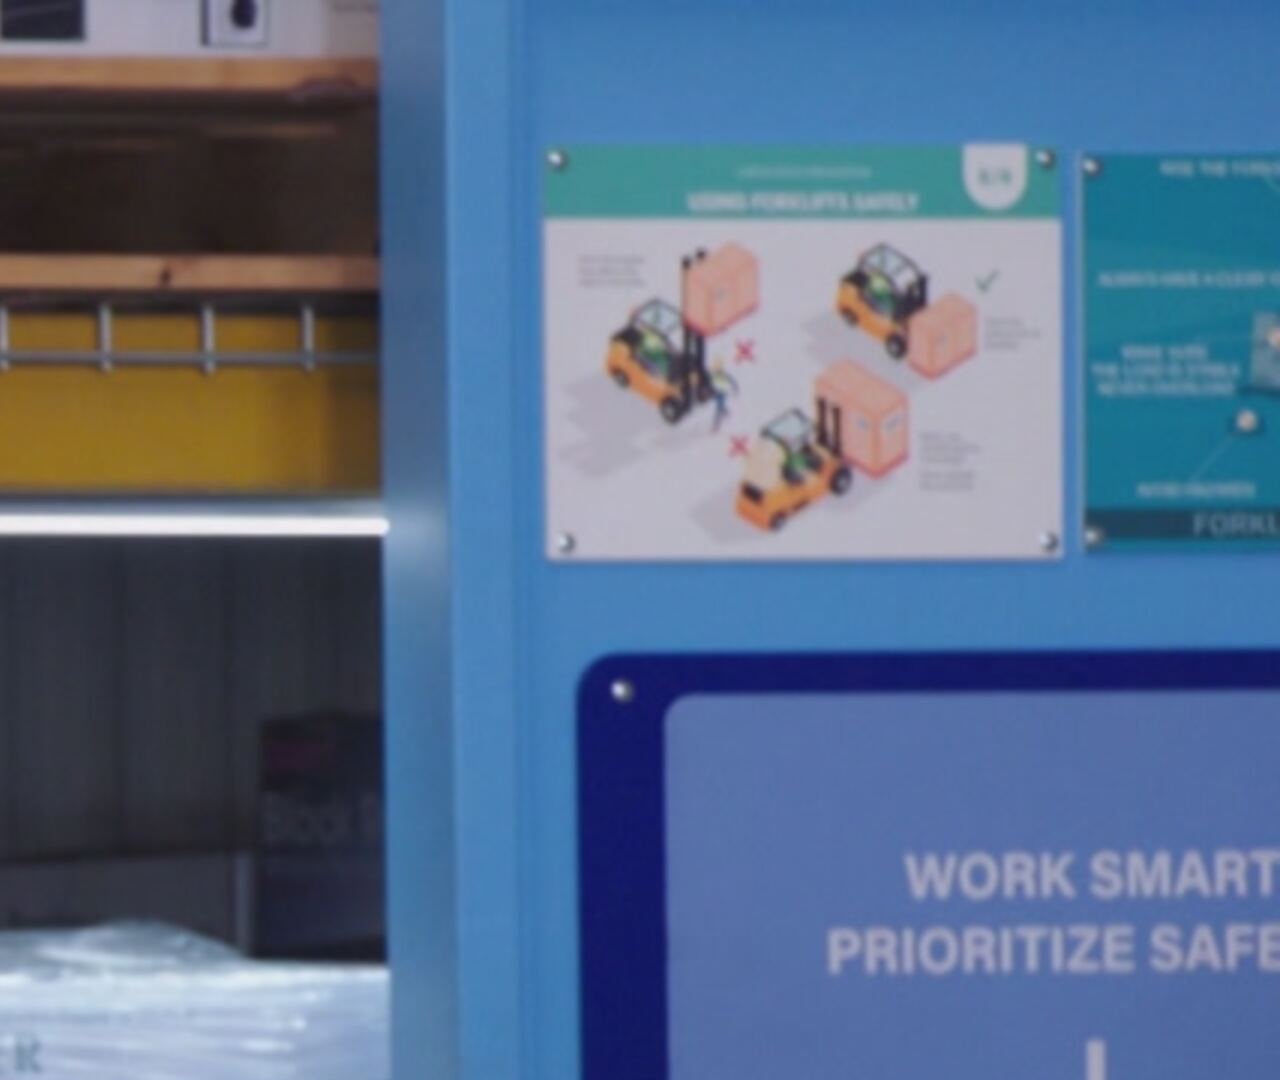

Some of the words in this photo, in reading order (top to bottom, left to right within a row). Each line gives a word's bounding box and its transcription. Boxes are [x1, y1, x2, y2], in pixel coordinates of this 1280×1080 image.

[903, 851, 1077, 900] WORK
[1090, 849, 1280, 898] SMART
[826, 926, 1137, 975] PRIORITIZE
[1149, 923, 1280, 973] SAFE
